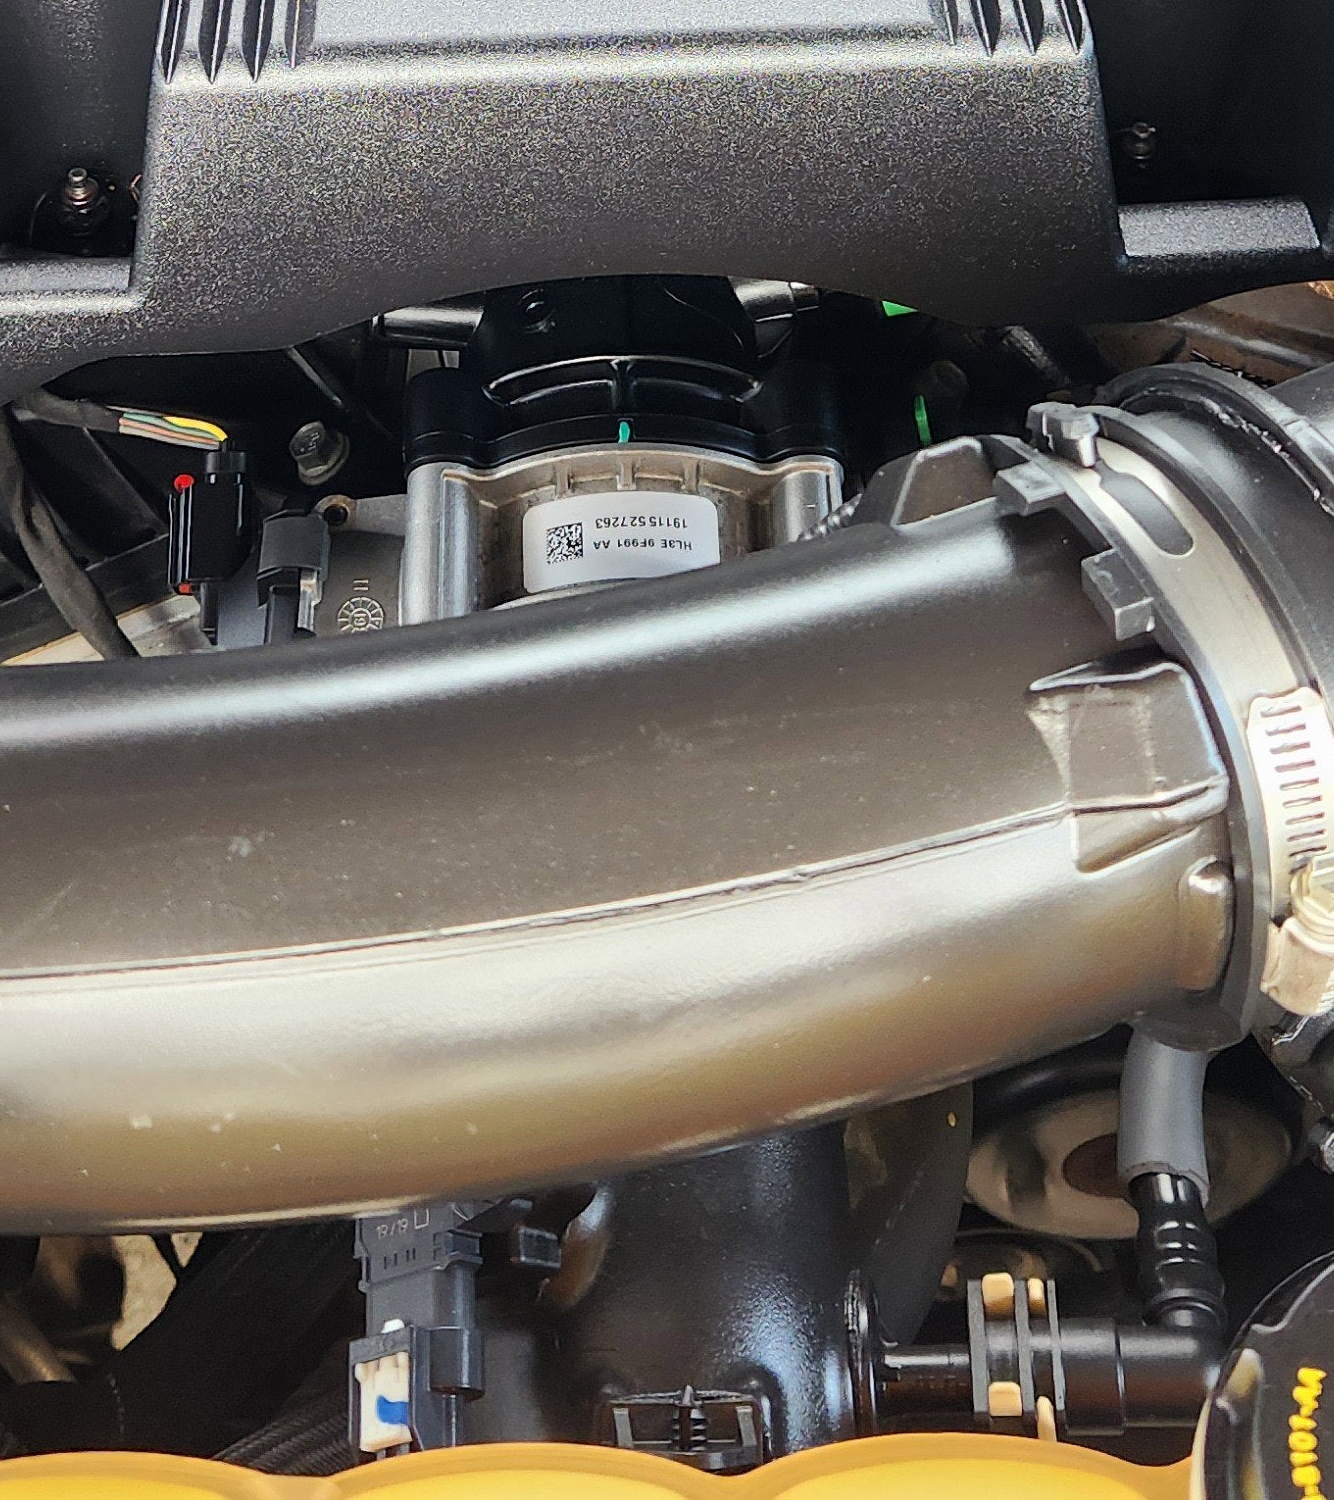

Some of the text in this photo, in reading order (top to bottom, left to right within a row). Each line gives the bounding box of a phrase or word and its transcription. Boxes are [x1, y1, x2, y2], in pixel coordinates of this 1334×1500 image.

[593, 538, 692, 551] HL3E 9F991 AA
